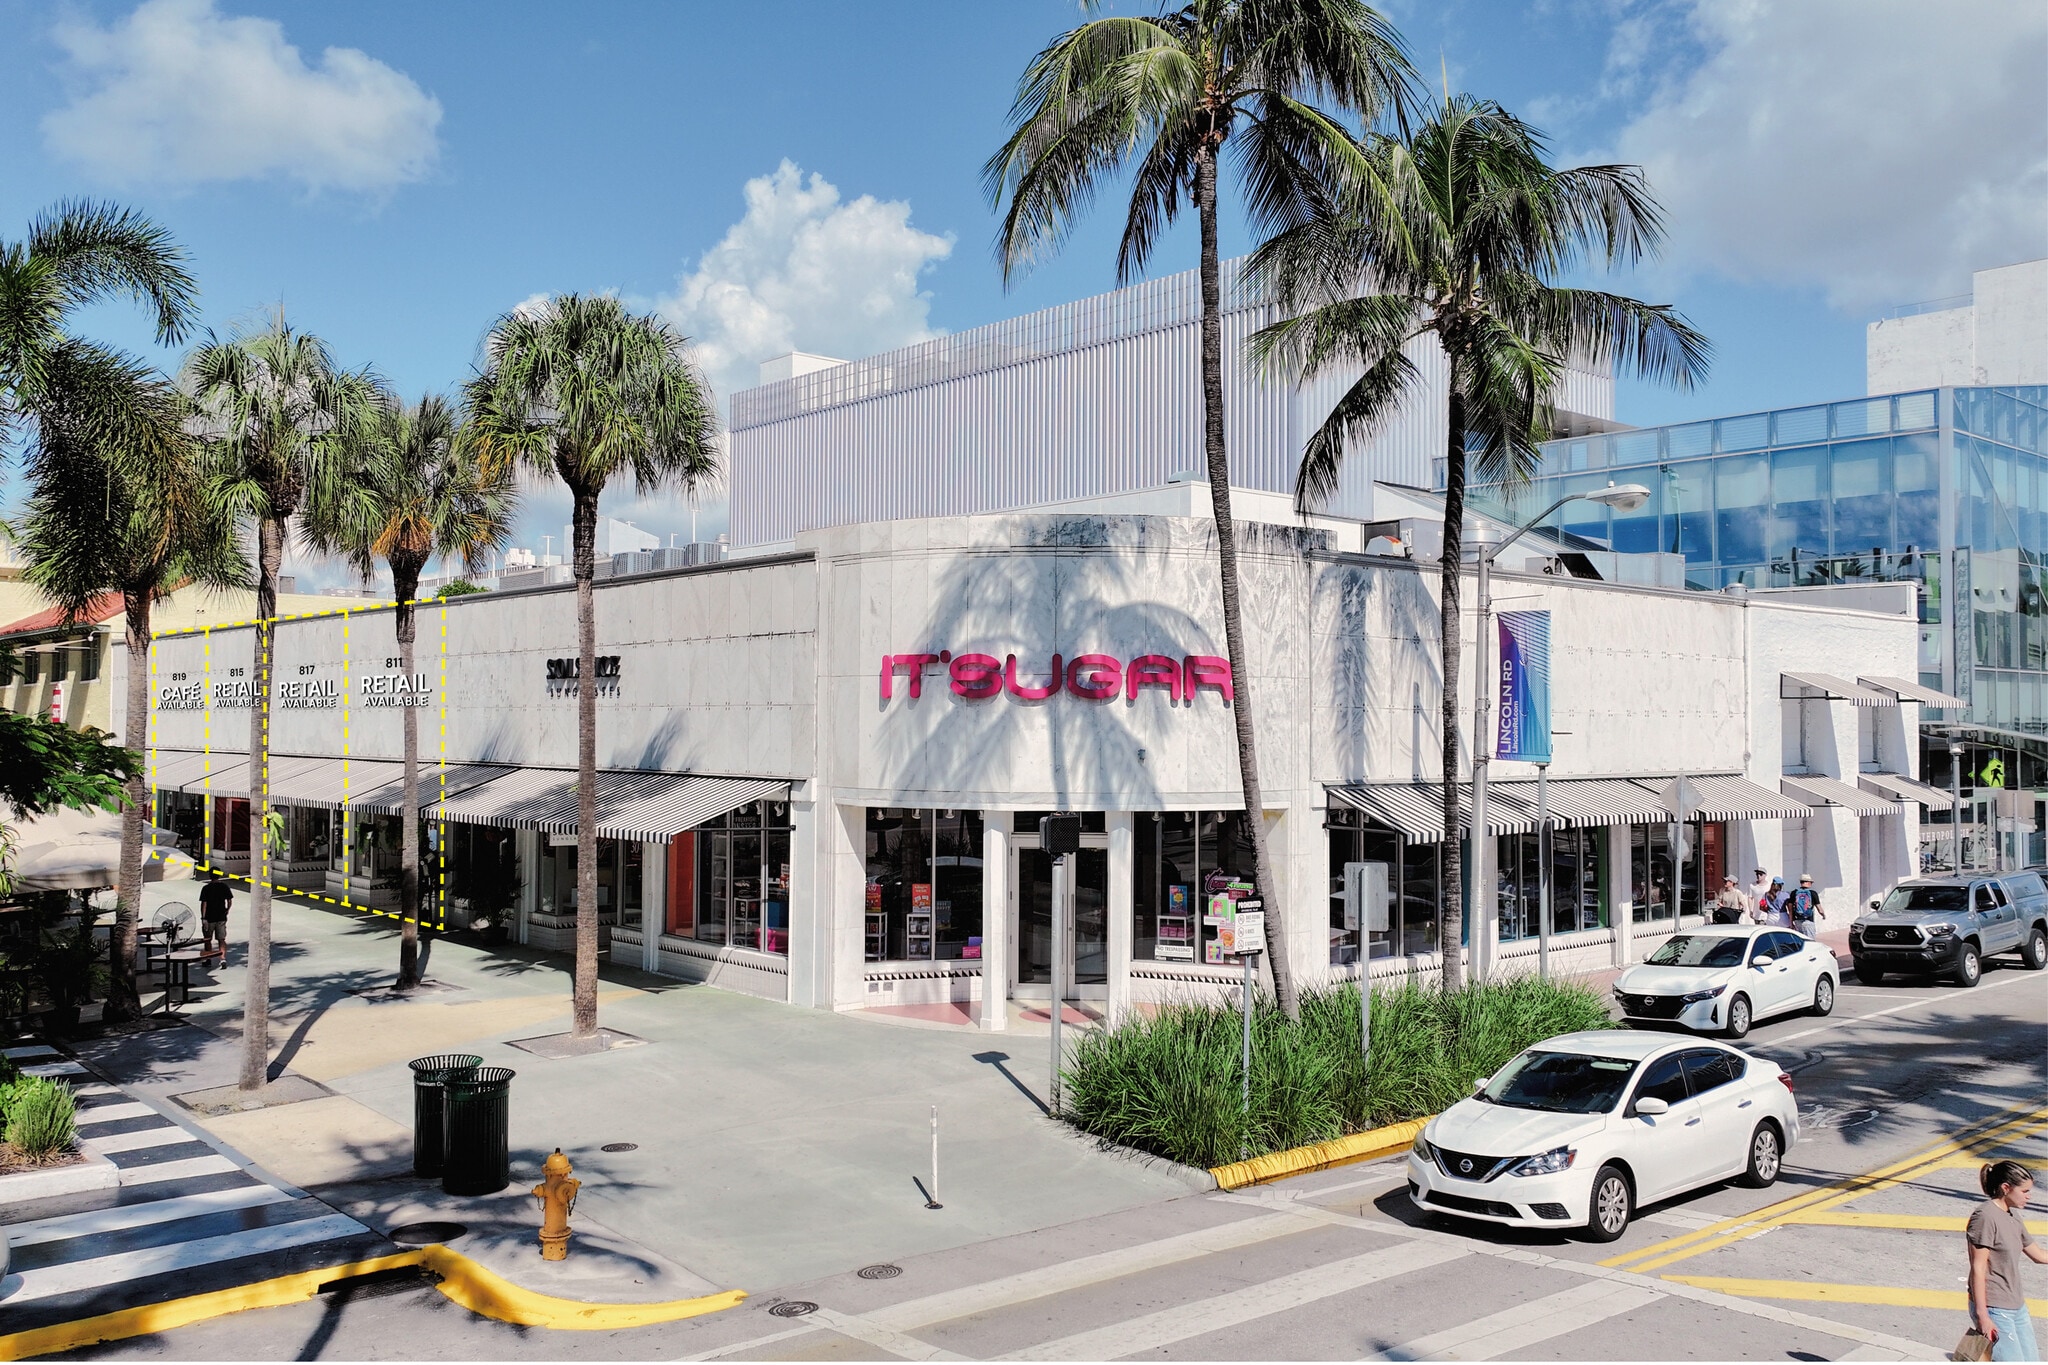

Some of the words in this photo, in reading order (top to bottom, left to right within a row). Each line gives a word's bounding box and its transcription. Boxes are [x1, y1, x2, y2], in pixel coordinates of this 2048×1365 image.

[1503, 660, 1513, 681] RD
[550, 686, 620, 698] SUNGSSES
[1501, 685, 1513, 754] LINCOLN
